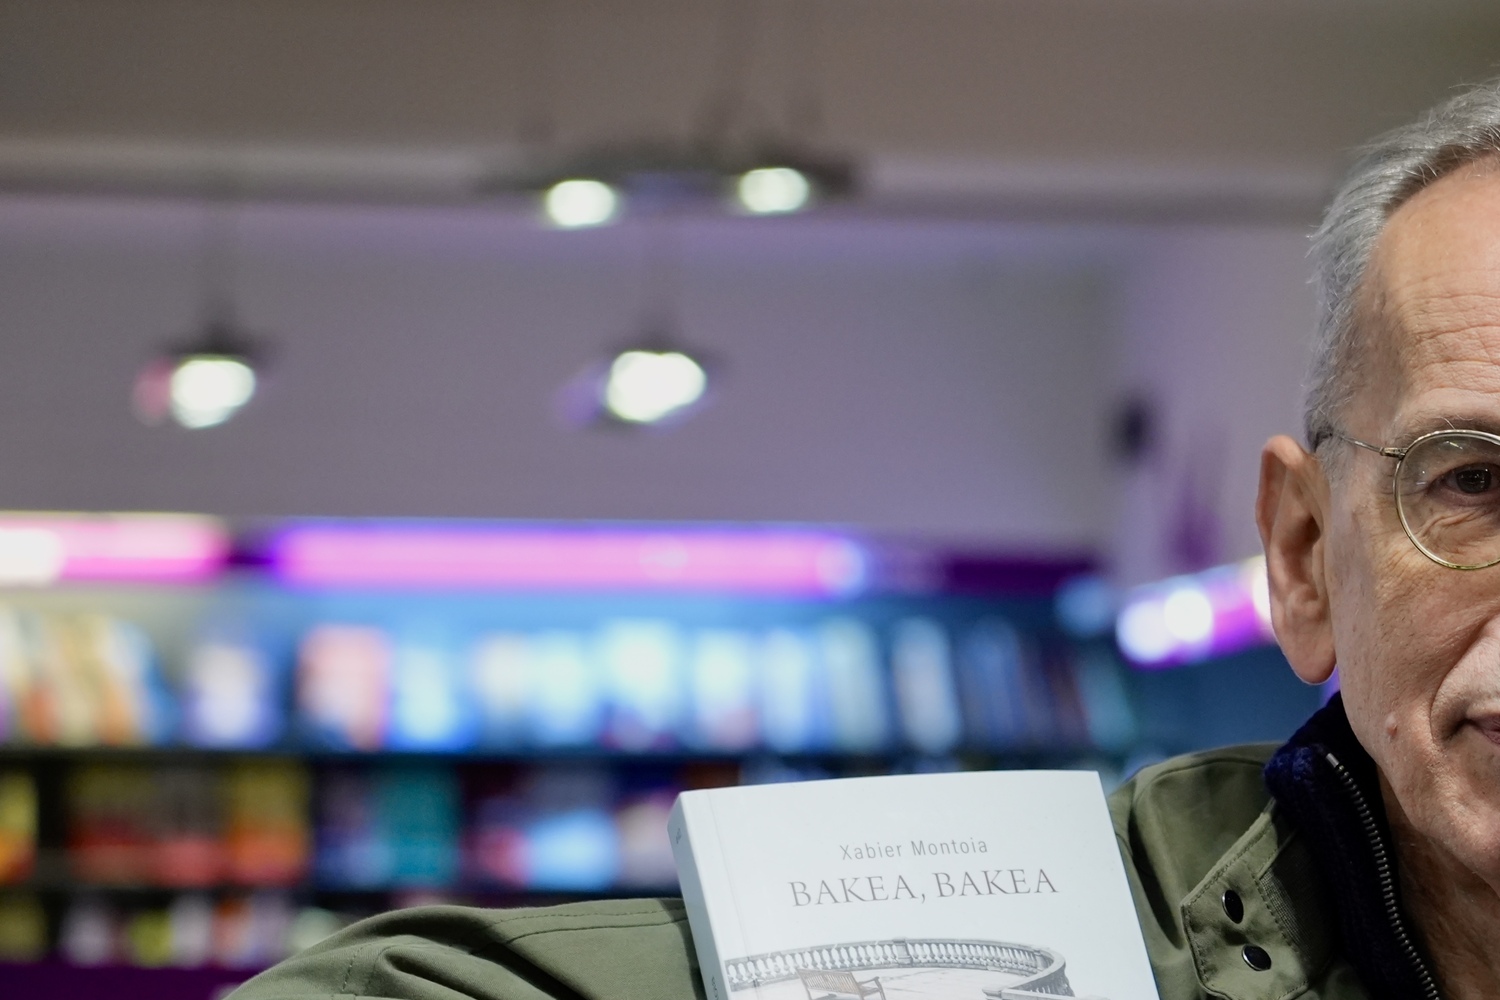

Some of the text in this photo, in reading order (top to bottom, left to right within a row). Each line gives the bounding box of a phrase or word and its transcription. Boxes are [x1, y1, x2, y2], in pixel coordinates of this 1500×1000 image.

[840, 837, 988, 861] Xabier Montoia
[788, 868, 1060, 906] BAKEA, BAKEA
